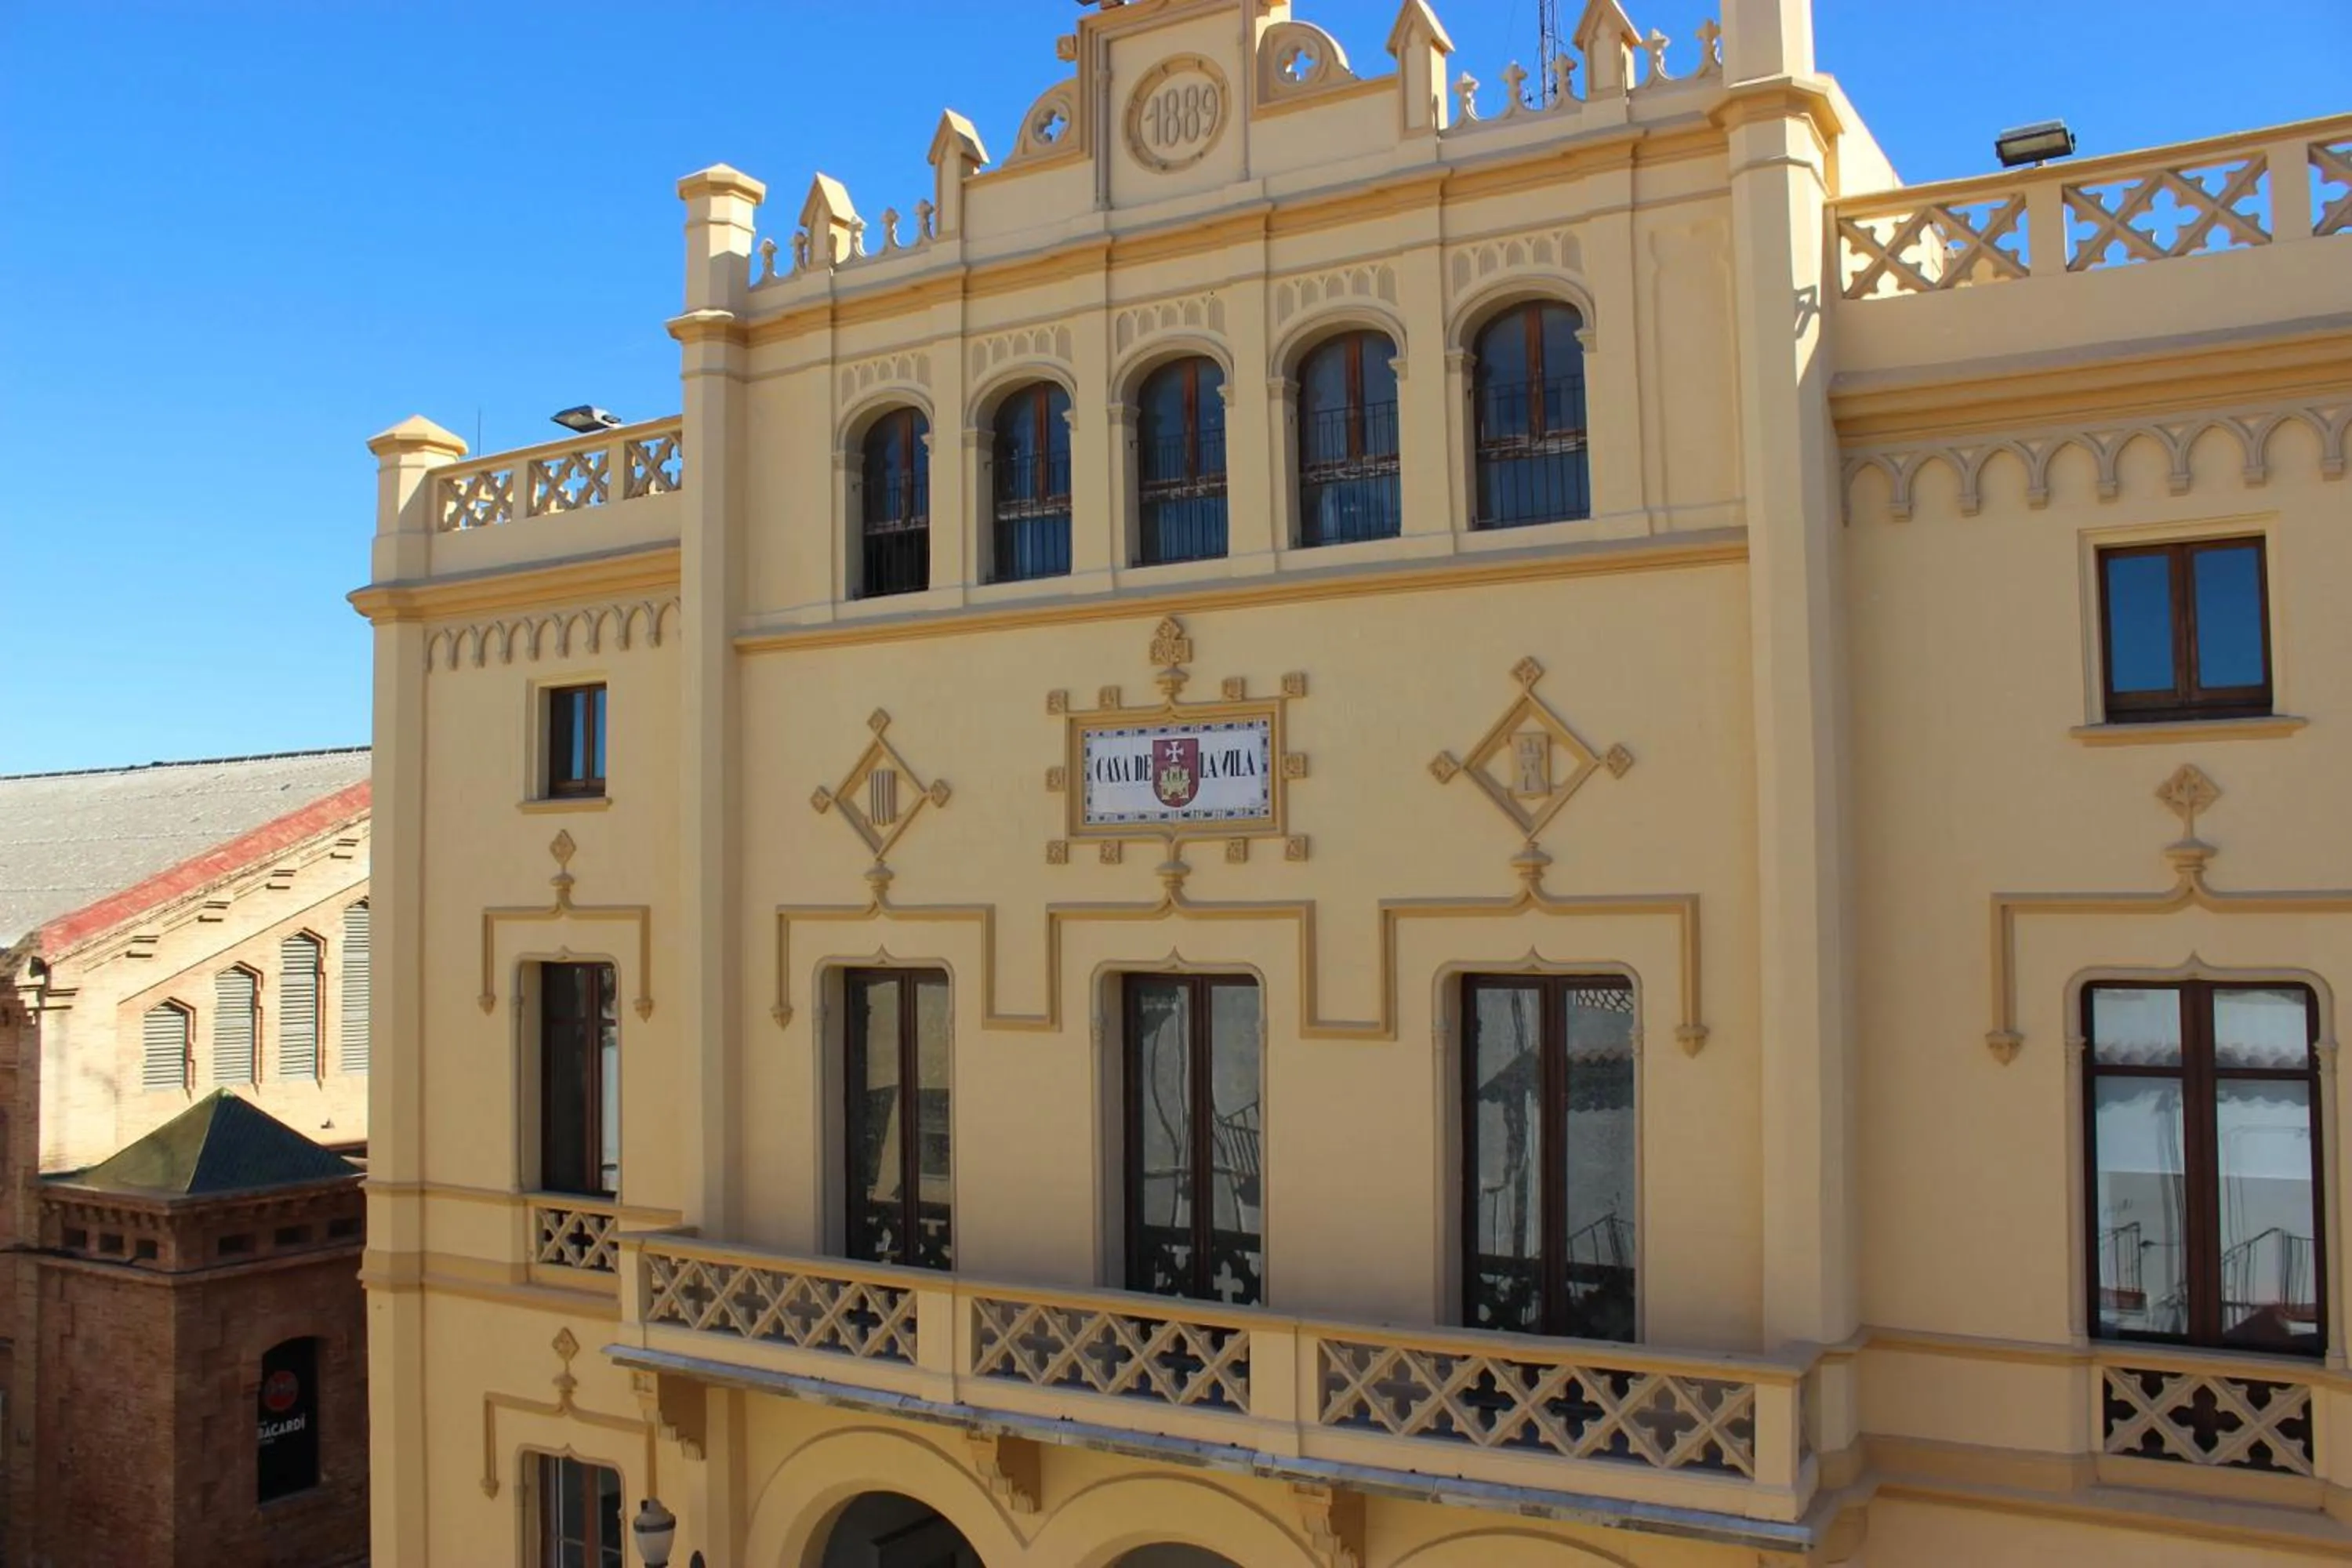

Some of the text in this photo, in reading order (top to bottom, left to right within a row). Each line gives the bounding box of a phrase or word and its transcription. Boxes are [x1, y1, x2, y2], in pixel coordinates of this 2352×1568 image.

[1145, 83, 1218, 147] 1889
[1096, 747, 1256, 783] CASA DE LA VILA
